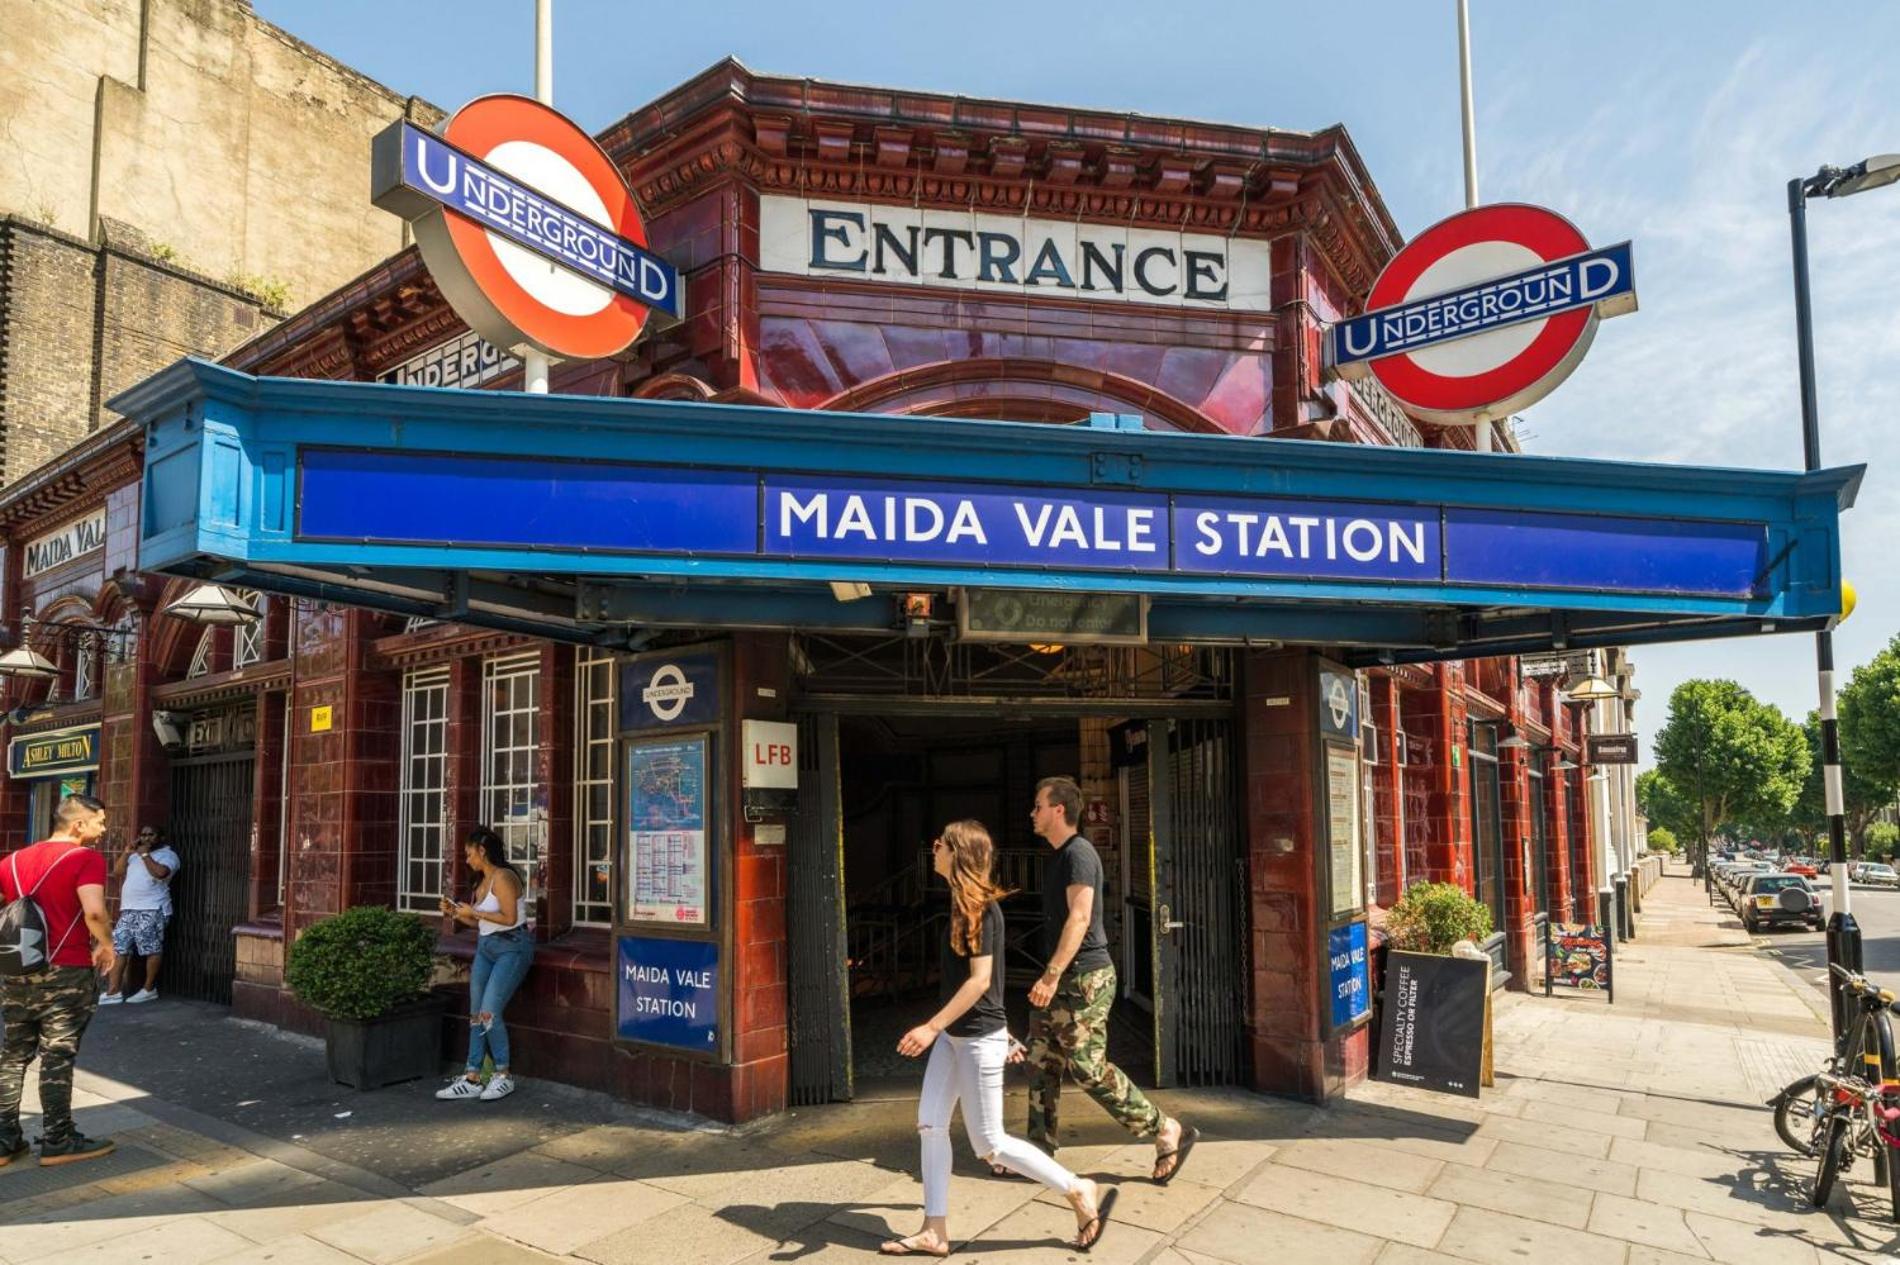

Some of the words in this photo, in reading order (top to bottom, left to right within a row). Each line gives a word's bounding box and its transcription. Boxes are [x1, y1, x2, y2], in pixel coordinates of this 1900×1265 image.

[417, 137, 668, 301] UNDERGROUND
[808, 208, 1229, 301] ENTRANCE
[1344, 257, 1620, 356] UNDERGROUND
[780, 491, 988, 545] MAIDA
[1014, 502, 1156, 552] VALE
[1195, 511, 1425, 564] STATION
[26, 532, 73, 576] MAIDA
[755, 743, 792, 765] LFB
[625, 964, 670, 985] MAIDA
[675, 969, 712, 989] VALE
[1330, 951, 1351, 972] MAIDA
[1350, 946, 1366, 965] VALE
[636, 996, 696, 1019] STATION
[1338, 975, 1362, 999] STATION
[1397, 965, 1411, 1008] COFFEE
[1408, 979, 1419, 1007] FILTER
[1407, 1008, 1416, 1022] OR
[1392, 1009, 1407, 1065] SPECIALTY
[1403, 1022, 1415, 1066] ESPRESSO
